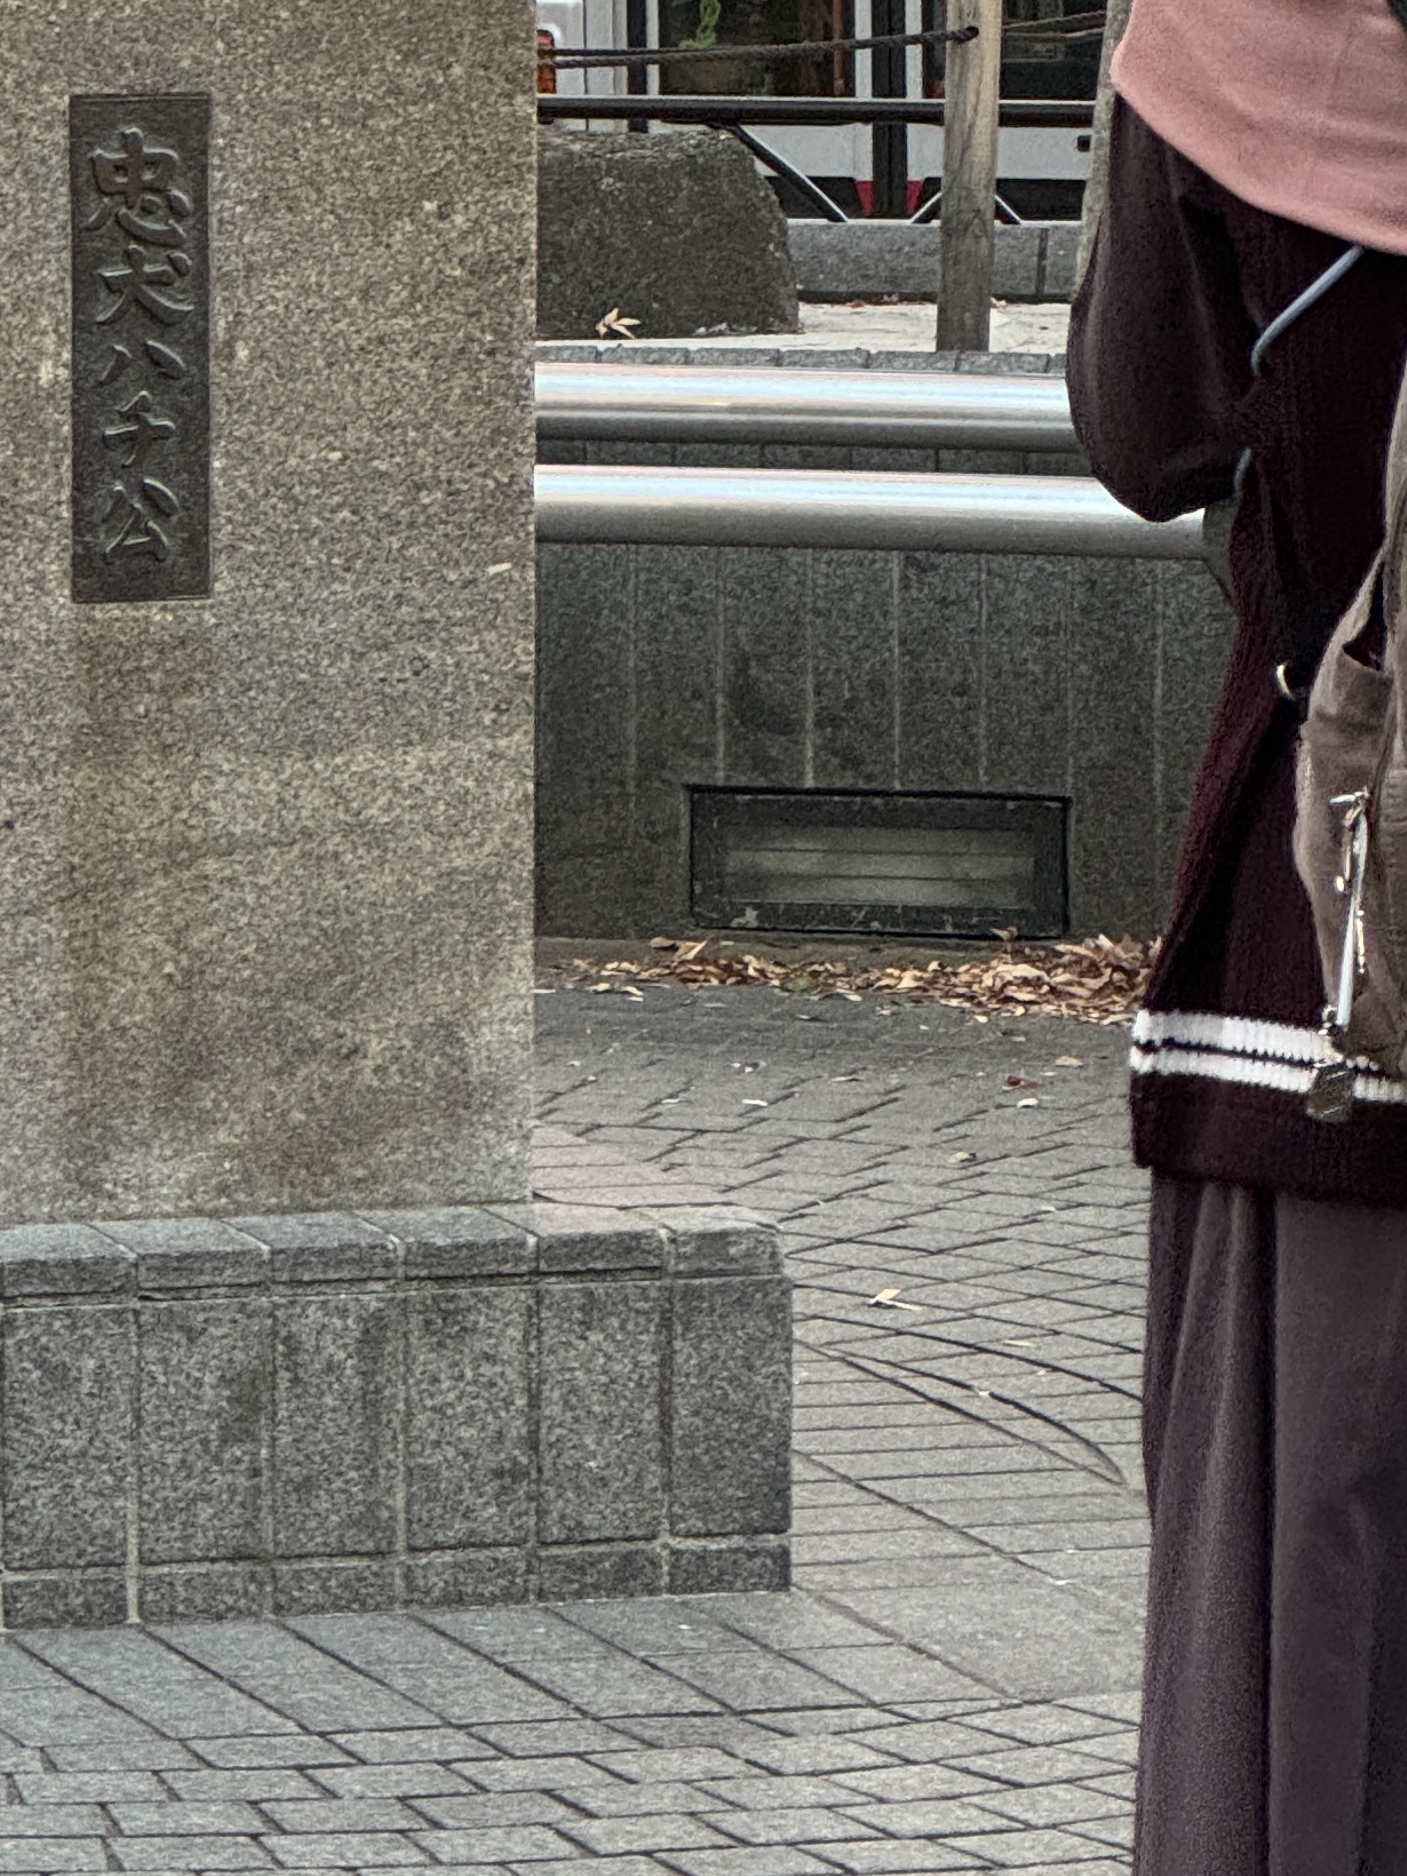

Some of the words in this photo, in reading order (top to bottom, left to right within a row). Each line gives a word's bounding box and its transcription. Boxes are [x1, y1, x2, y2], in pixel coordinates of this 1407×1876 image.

[86, 127, 195, 564] 忠犬ハチ公
